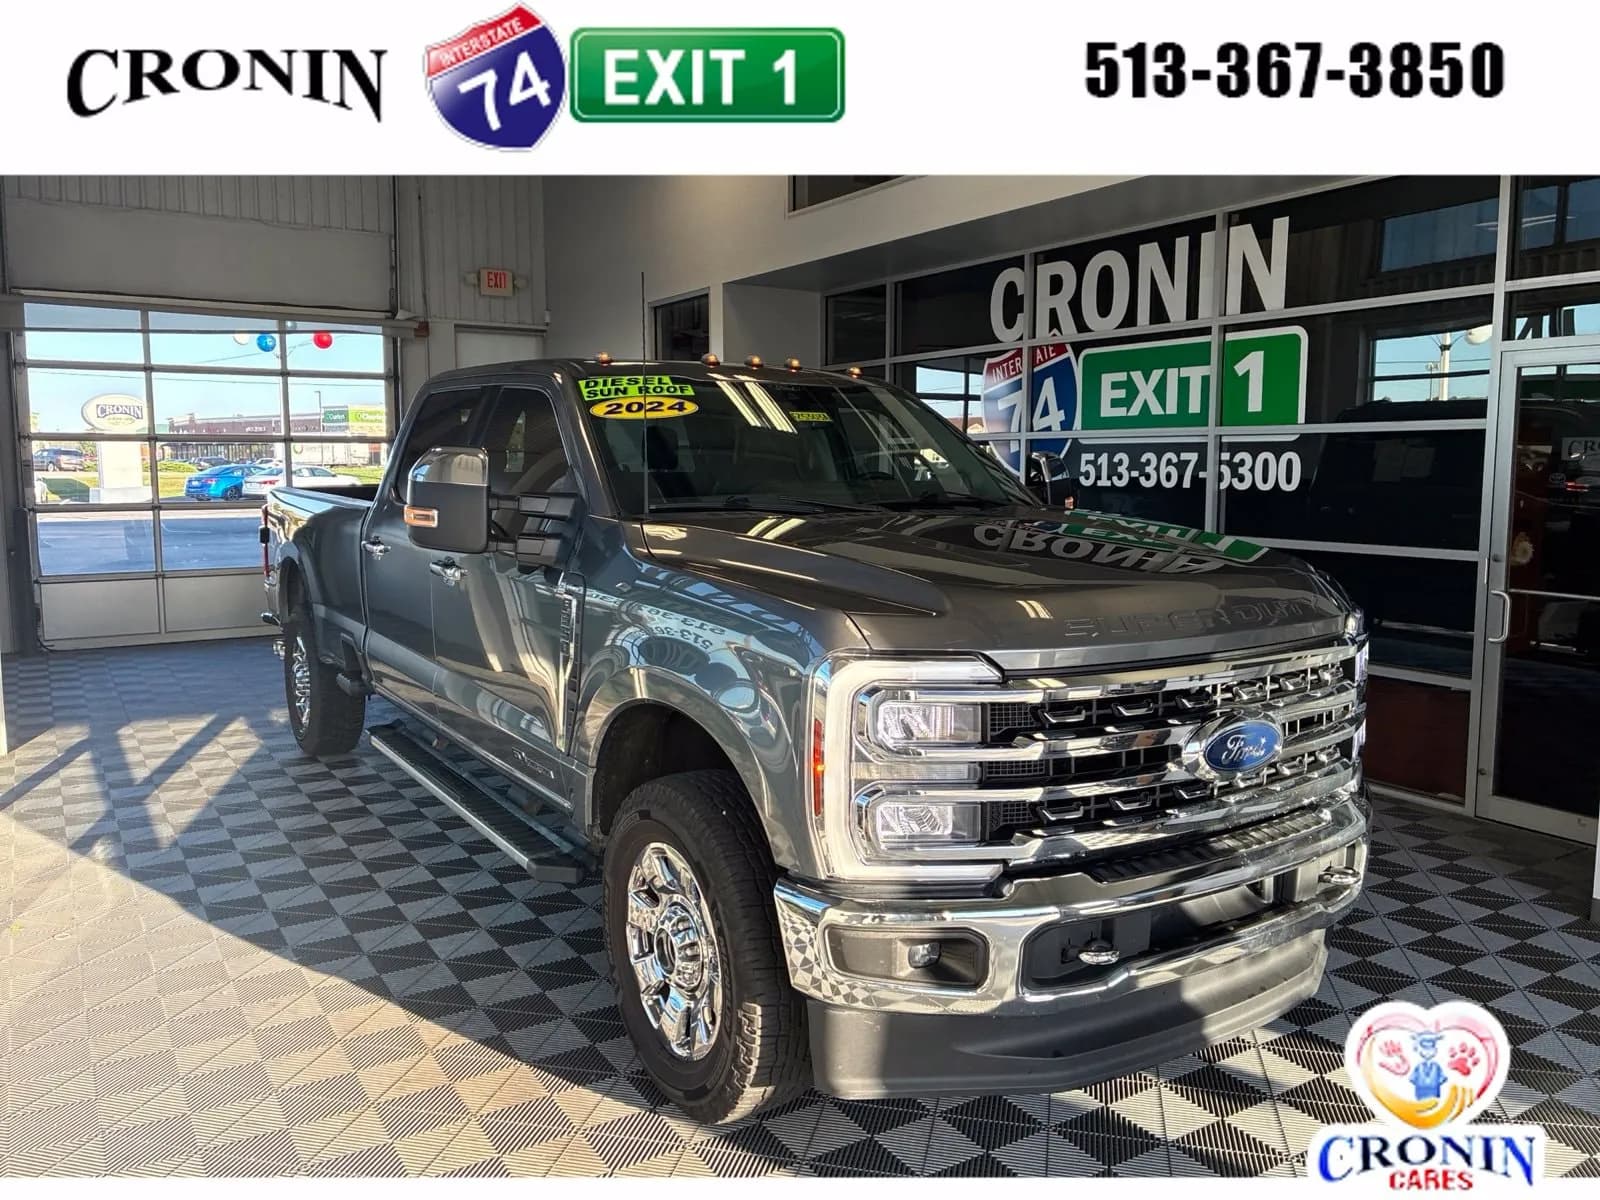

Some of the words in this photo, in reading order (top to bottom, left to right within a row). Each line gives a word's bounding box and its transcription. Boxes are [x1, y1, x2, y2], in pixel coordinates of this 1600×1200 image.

[487, 271, 507, 289] EXIT
[990, 216, 1290, 343] CRONIN
[992, 343, 1058, 384] INTERATE
[584, 377, 670, 389] DIESEL
[586, 387, 628, 399] SUN
[637, 385, 690, 396] ROOF
[1101, 365, 1211, 419] EXIT
[1233, 350, 1265, 413] 1
[96, 404, 144, 419] CRONIN
[603, 401, 687, 415] 2024
[997, 376, 1066, 453] 74
[1079, 450, 1301, 493] 513-367-5300
[1221, 734, 1267, 765] Ford
